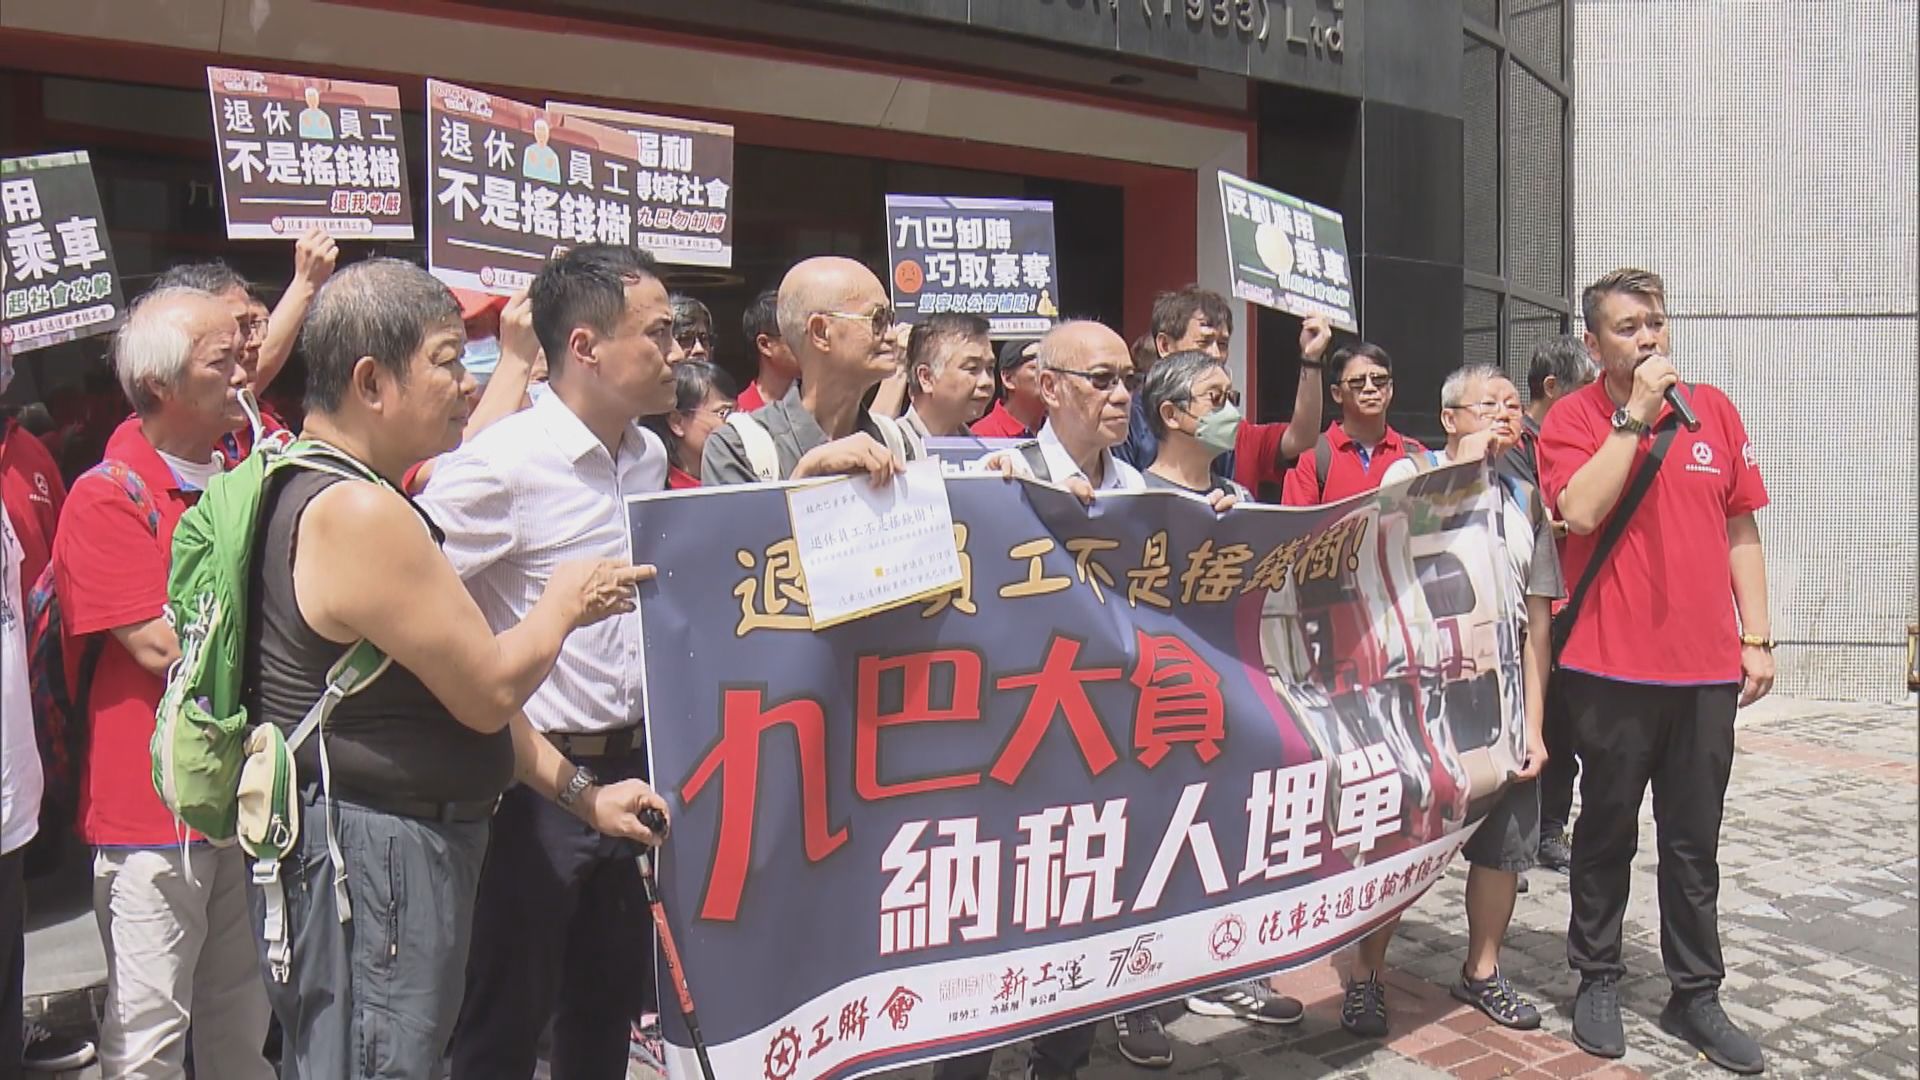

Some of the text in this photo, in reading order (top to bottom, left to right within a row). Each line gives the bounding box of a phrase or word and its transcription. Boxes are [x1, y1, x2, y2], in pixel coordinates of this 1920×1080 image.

[225, 140, 400, 188] 不是搖錢樹
[438, 167, 631, 246] 不是搖錢樹
[6, 216, 108, 282] 乘車
[924, 251, 1051, 290] 巧取豪奪
[733, 515, 1370, 638] 退員工不是搖錢樹!
[1258, 839, 1463, 946] 汽車交通運輸業總工
[807, 985, 923, 1058] 工聯會
